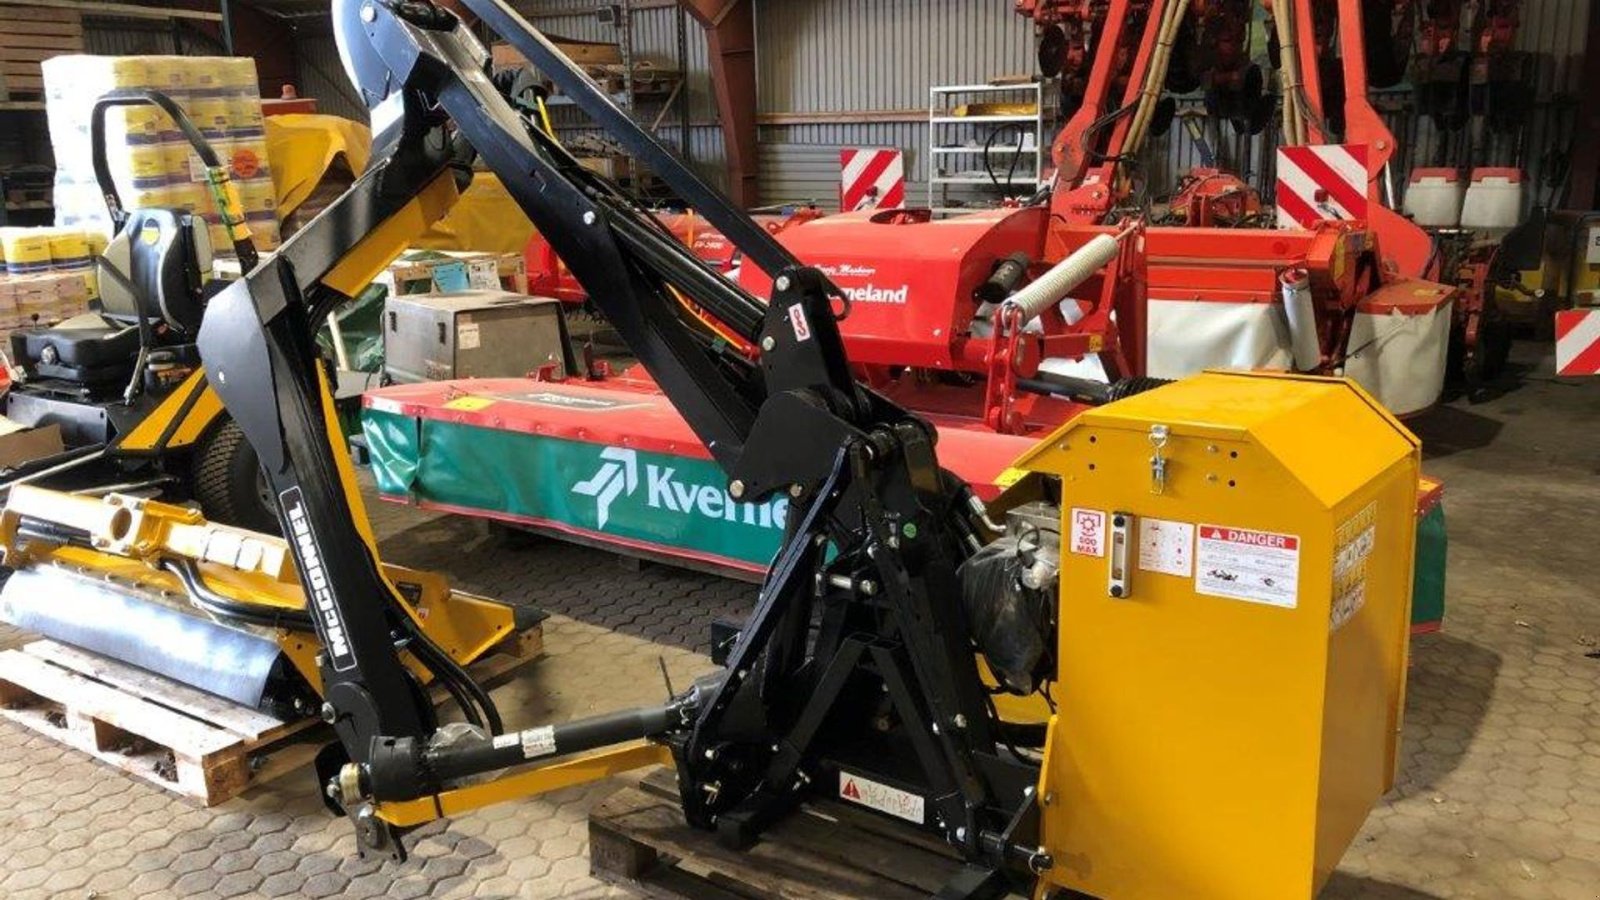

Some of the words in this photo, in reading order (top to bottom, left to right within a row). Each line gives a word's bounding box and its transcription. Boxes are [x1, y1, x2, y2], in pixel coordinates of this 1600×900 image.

[829, 283, 908, 304] neland
[1227, 531, 1287, 549] DANGER
[1076, 545, 1099, 555] MAX
